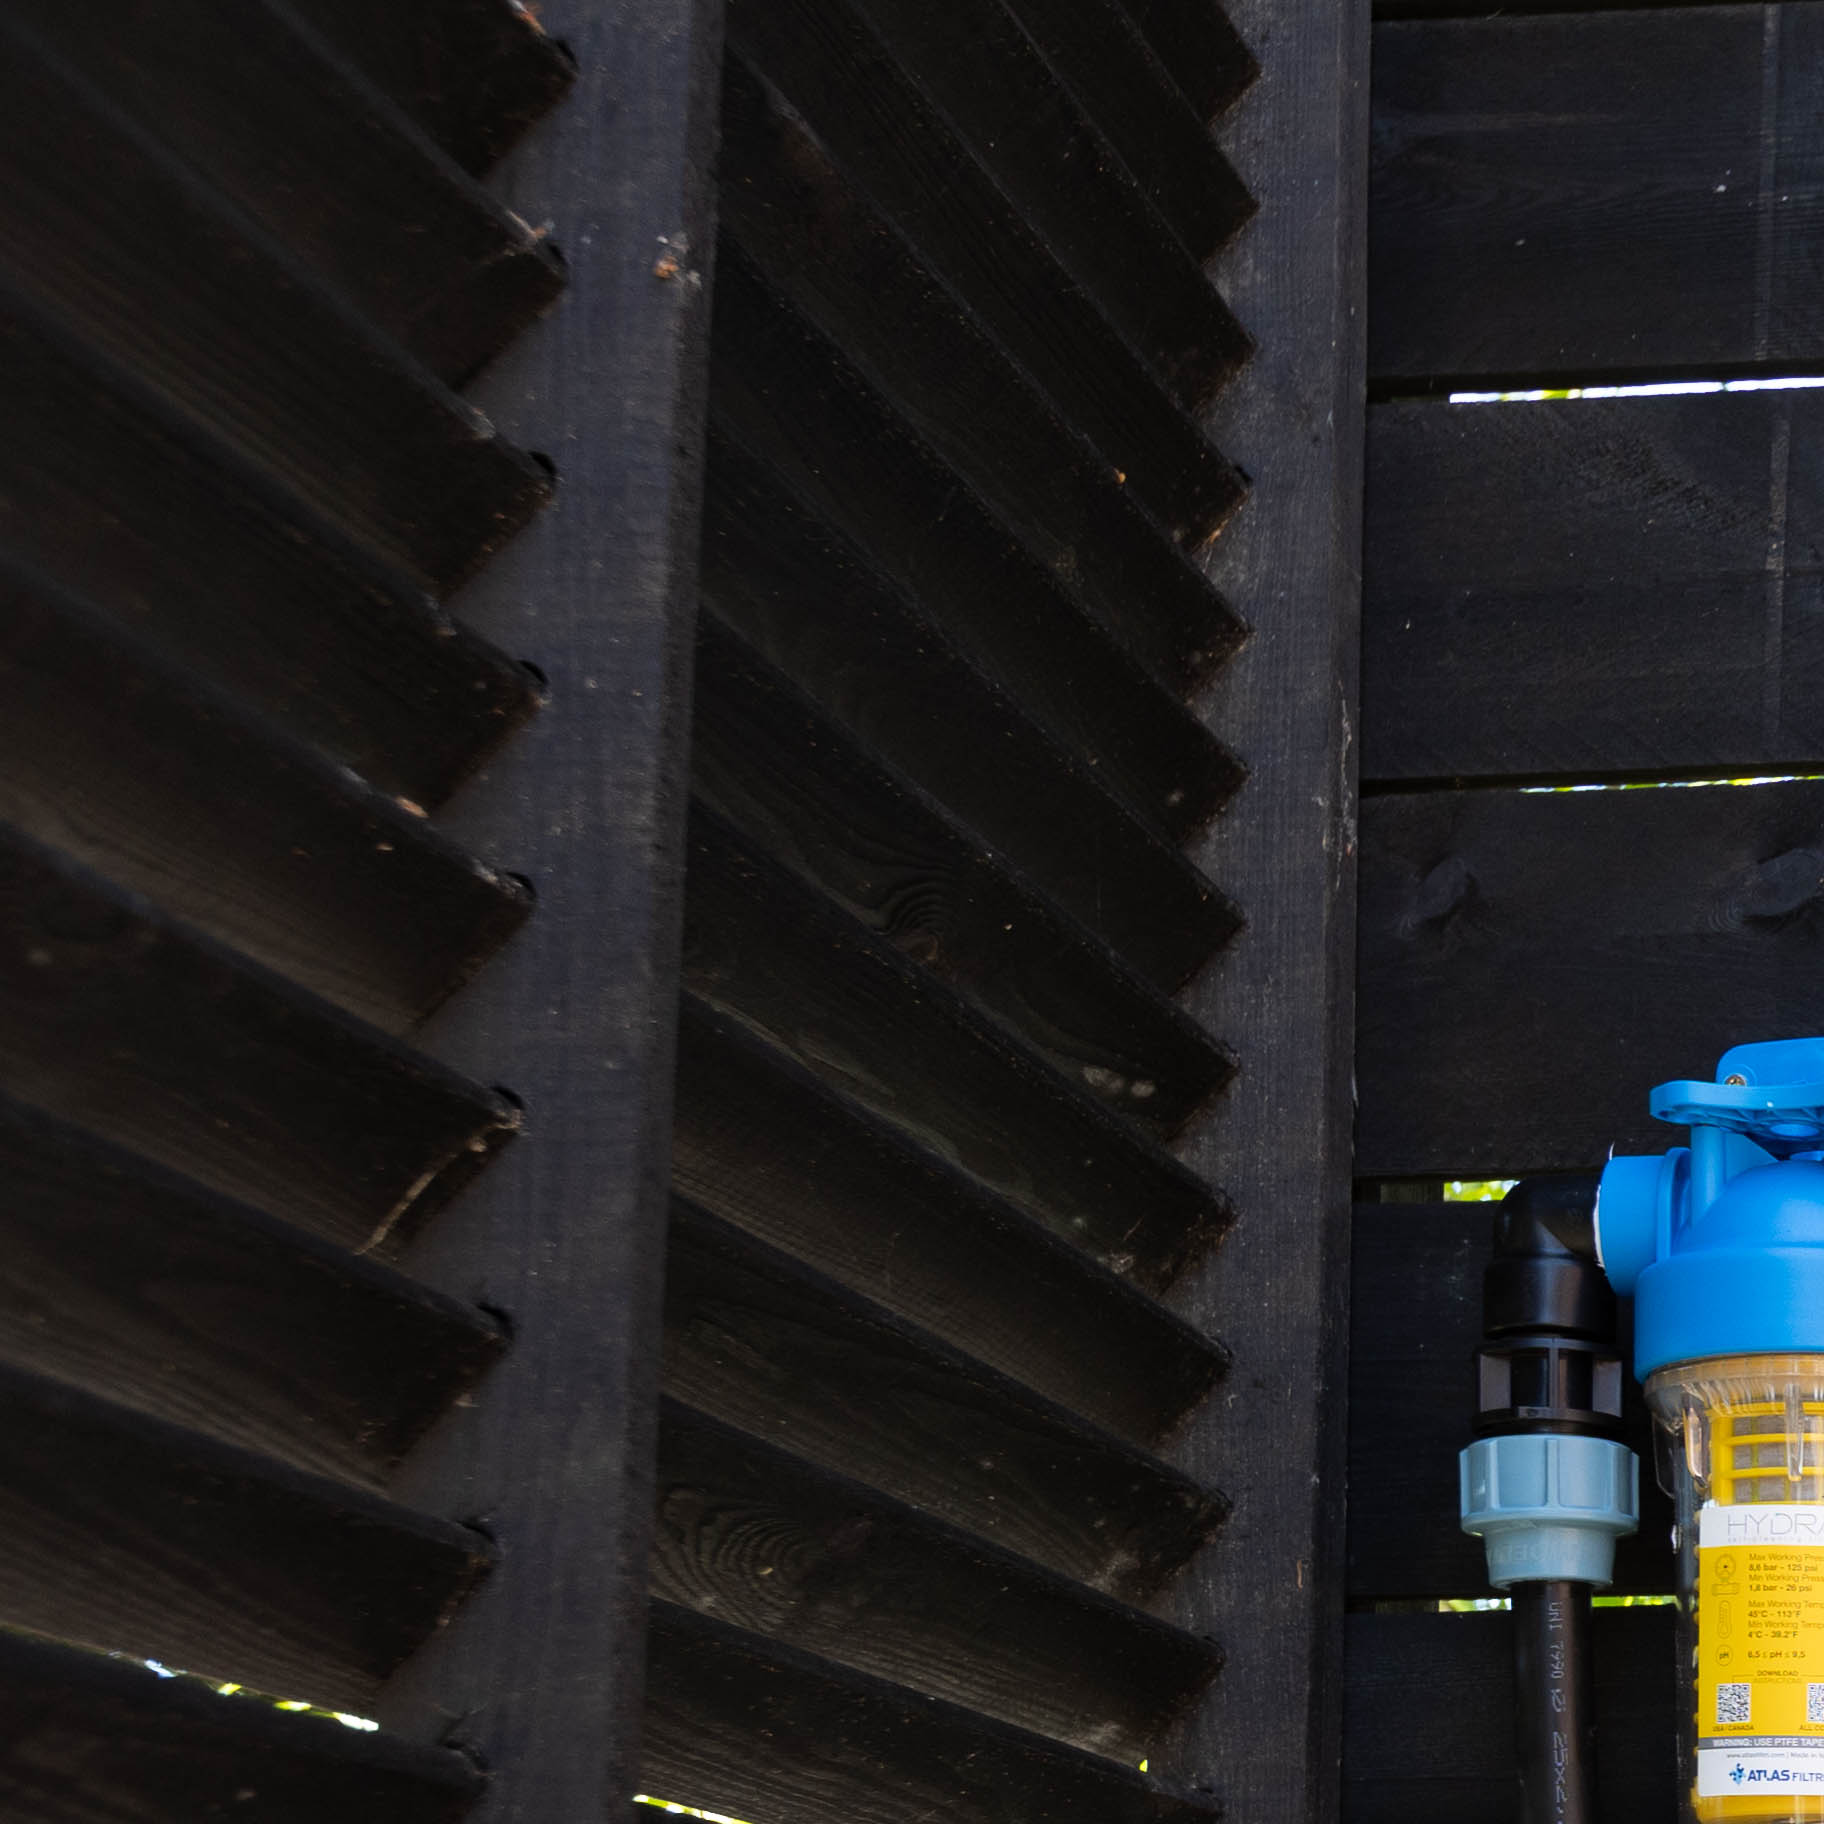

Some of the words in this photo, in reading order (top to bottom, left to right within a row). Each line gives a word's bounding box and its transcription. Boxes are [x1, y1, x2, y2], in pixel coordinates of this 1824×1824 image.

[1754, 1737, 1773, 1746] USE
[1774, 1738, 1799, 1747] PTFE
[1800, 1738, 1824, 1747] TAPE
[1747, 1769, 1790, 1781] ATLAS
